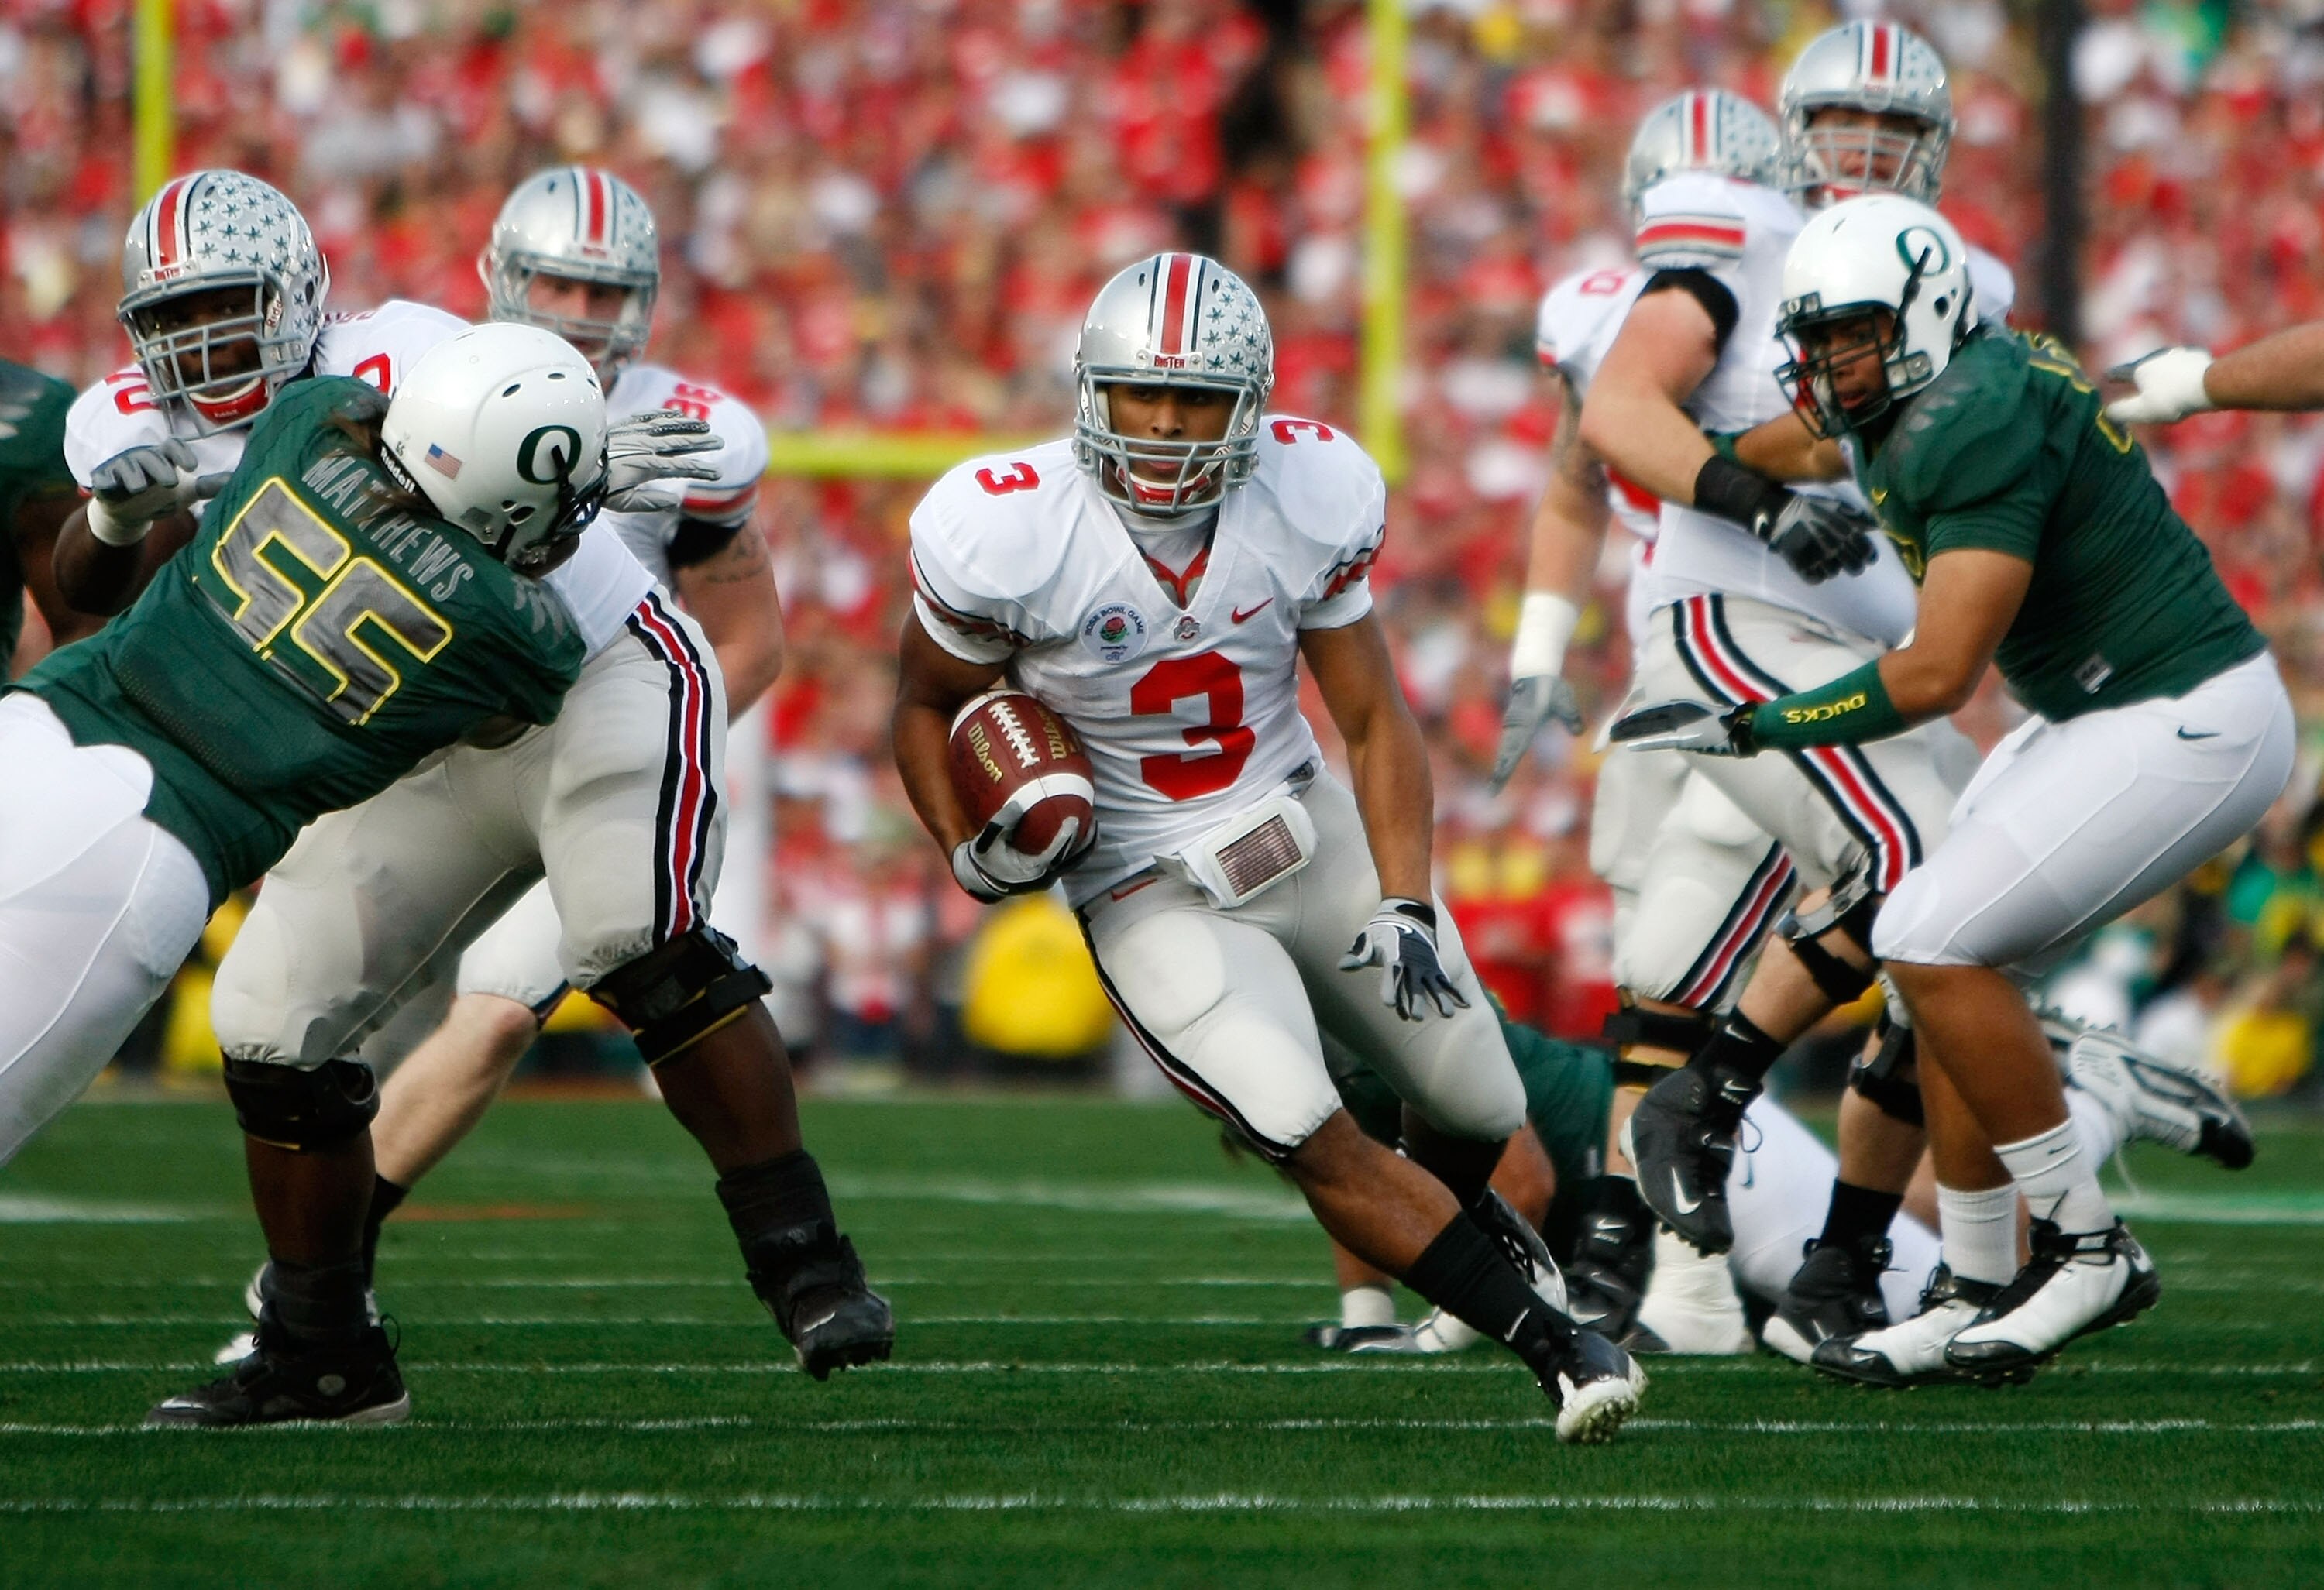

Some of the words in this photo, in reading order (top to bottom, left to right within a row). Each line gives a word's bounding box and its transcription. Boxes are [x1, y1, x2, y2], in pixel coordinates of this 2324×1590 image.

[380, 446, 417, 493] Riddell
[975, 462, 1040, 496] 3
[211, 476, 453, 726] 55
[1100, 606, 1126, 616] BOWL
[1130, 651, 1256, 801] 3
[1786, 694, 1866, 724] DUCKS
[968, 721, 1003, 784] Wilson
